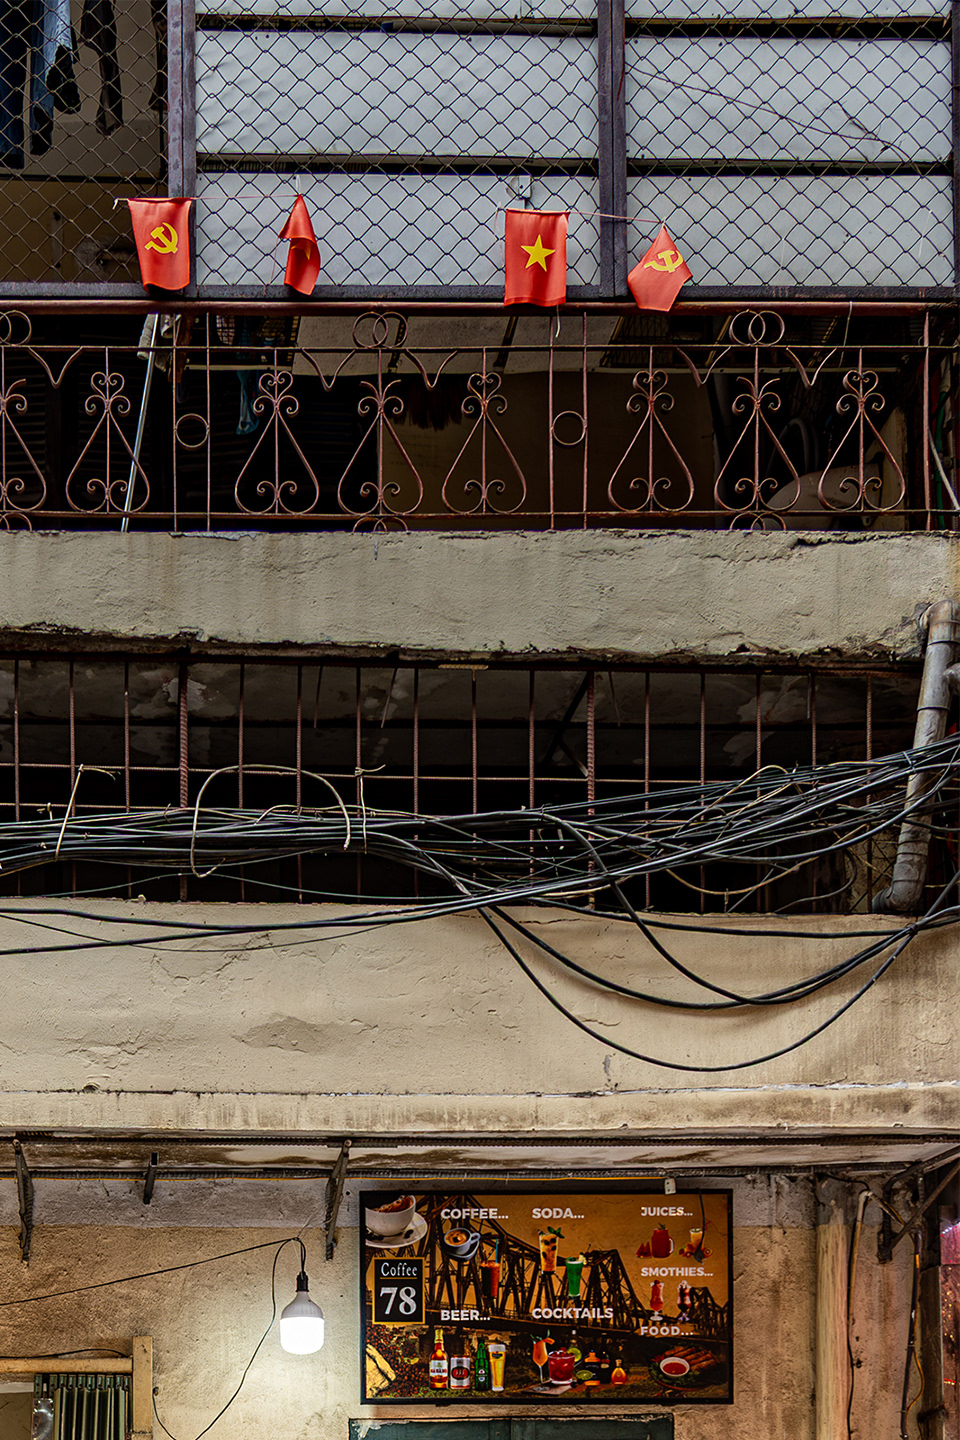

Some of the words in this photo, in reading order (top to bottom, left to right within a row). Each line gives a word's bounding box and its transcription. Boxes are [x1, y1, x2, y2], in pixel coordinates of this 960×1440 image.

[440, 1208, 509, 1220] COFFEE...
[532, 1207, 585, 1219] SODA...
[641, 1206, 693, 1217] JUICES...
[380, 1262, 418, 1276] Coffee
[641, 1267, 714, 1277] SMOTHIES...
[380, 1286, 417, 1315] 78
[440, 1309, 490, 1321] BEER...
[532, 1308, 614, 1319] COCKTAILS
[641, 1326, 694, 1336] FOOD...
